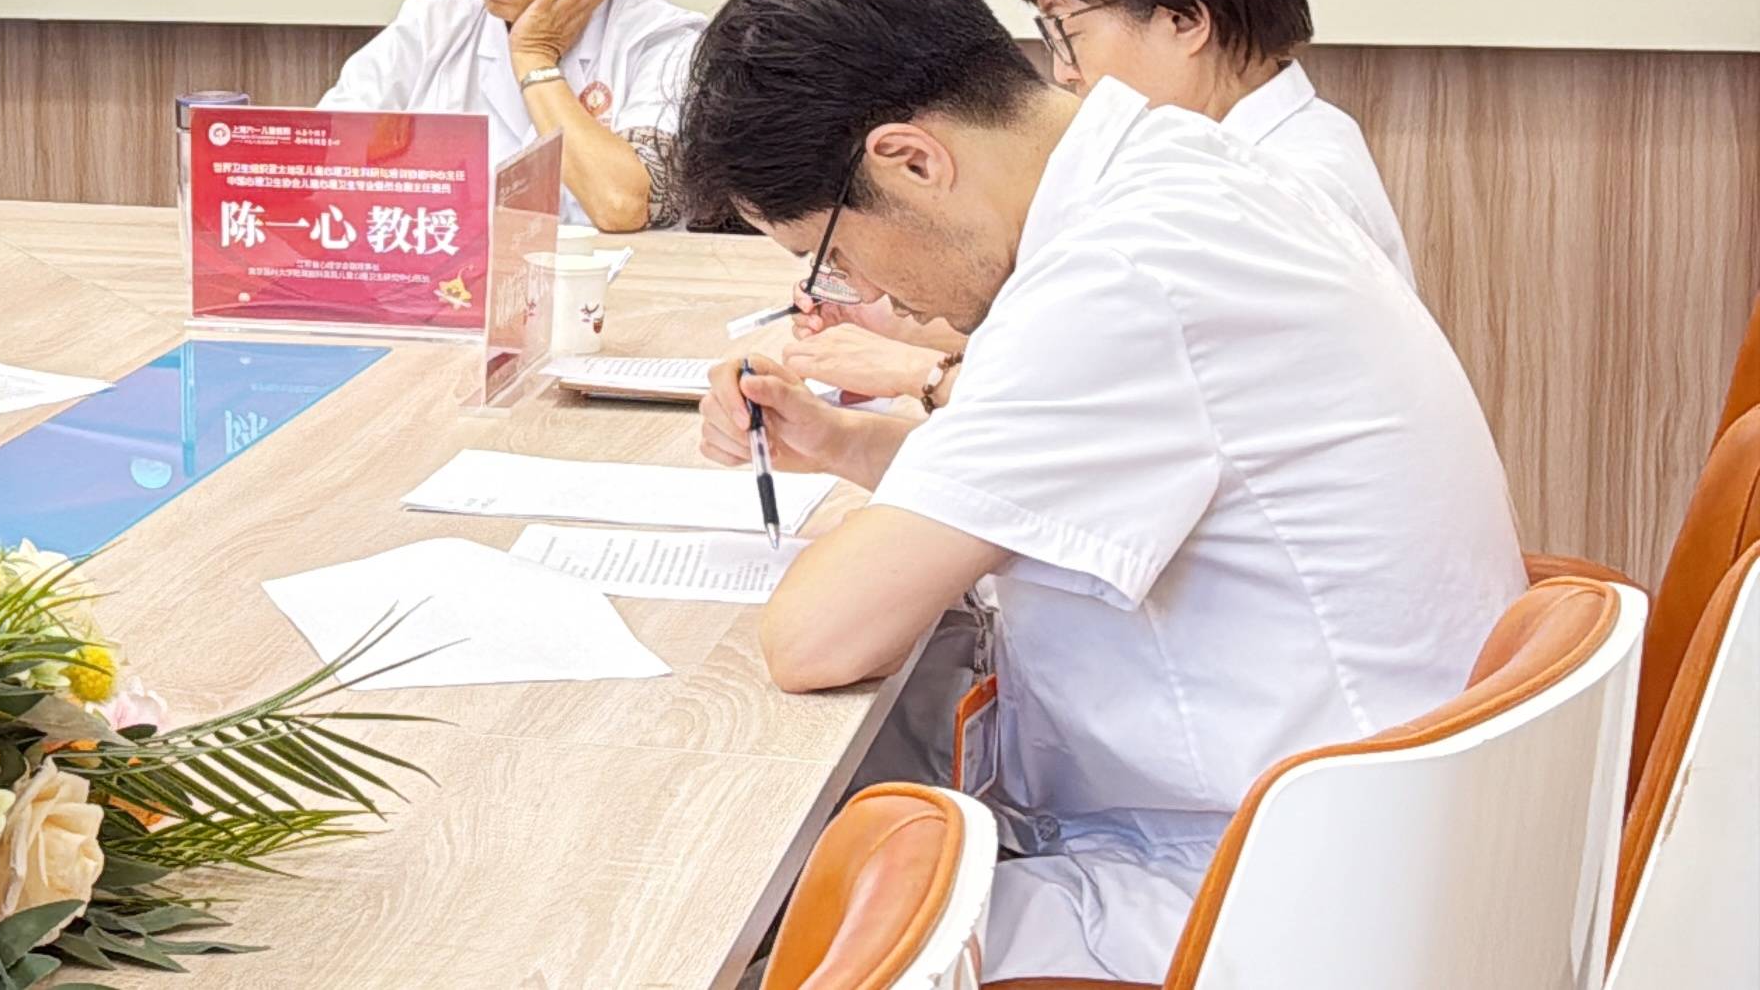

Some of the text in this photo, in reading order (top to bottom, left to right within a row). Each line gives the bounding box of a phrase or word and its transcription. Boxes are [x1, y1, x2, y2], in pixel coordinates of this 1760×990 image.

[220, 200, 461, 256] 陈一心 教授
